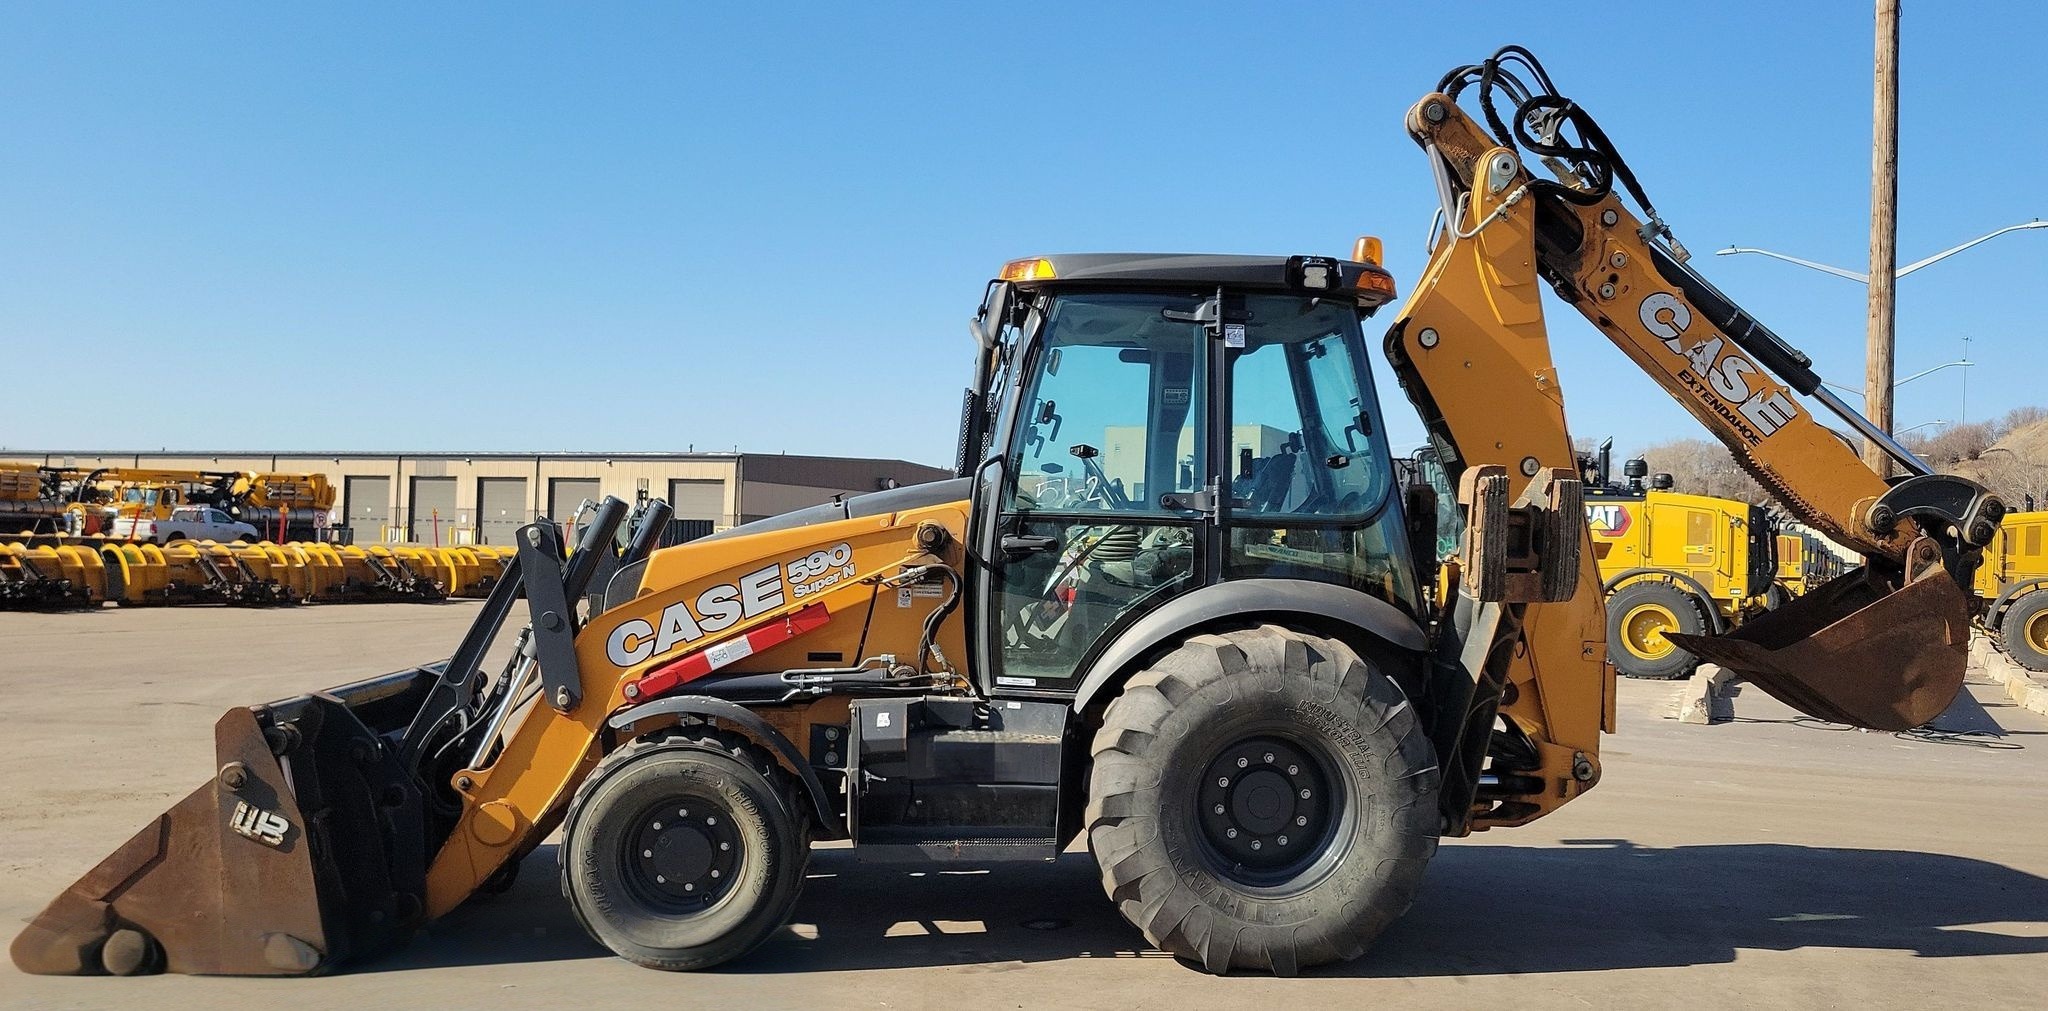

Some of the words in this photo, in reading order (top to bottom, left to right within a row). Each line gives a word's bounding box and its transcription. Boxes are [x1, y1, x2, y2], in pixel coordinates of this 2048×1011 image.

[1639, 292, 1798, 437] CASE
[1677, 369, 1763, 446] EXTENDAHOE
[786, 542, 853, 584] 590
[793, 572, 841, 598] Super
[842, 563, 856, 580] N
[606, 563, 785, 667] CASE
[1297, 699, 1377, 762] INDUSTRIAL
